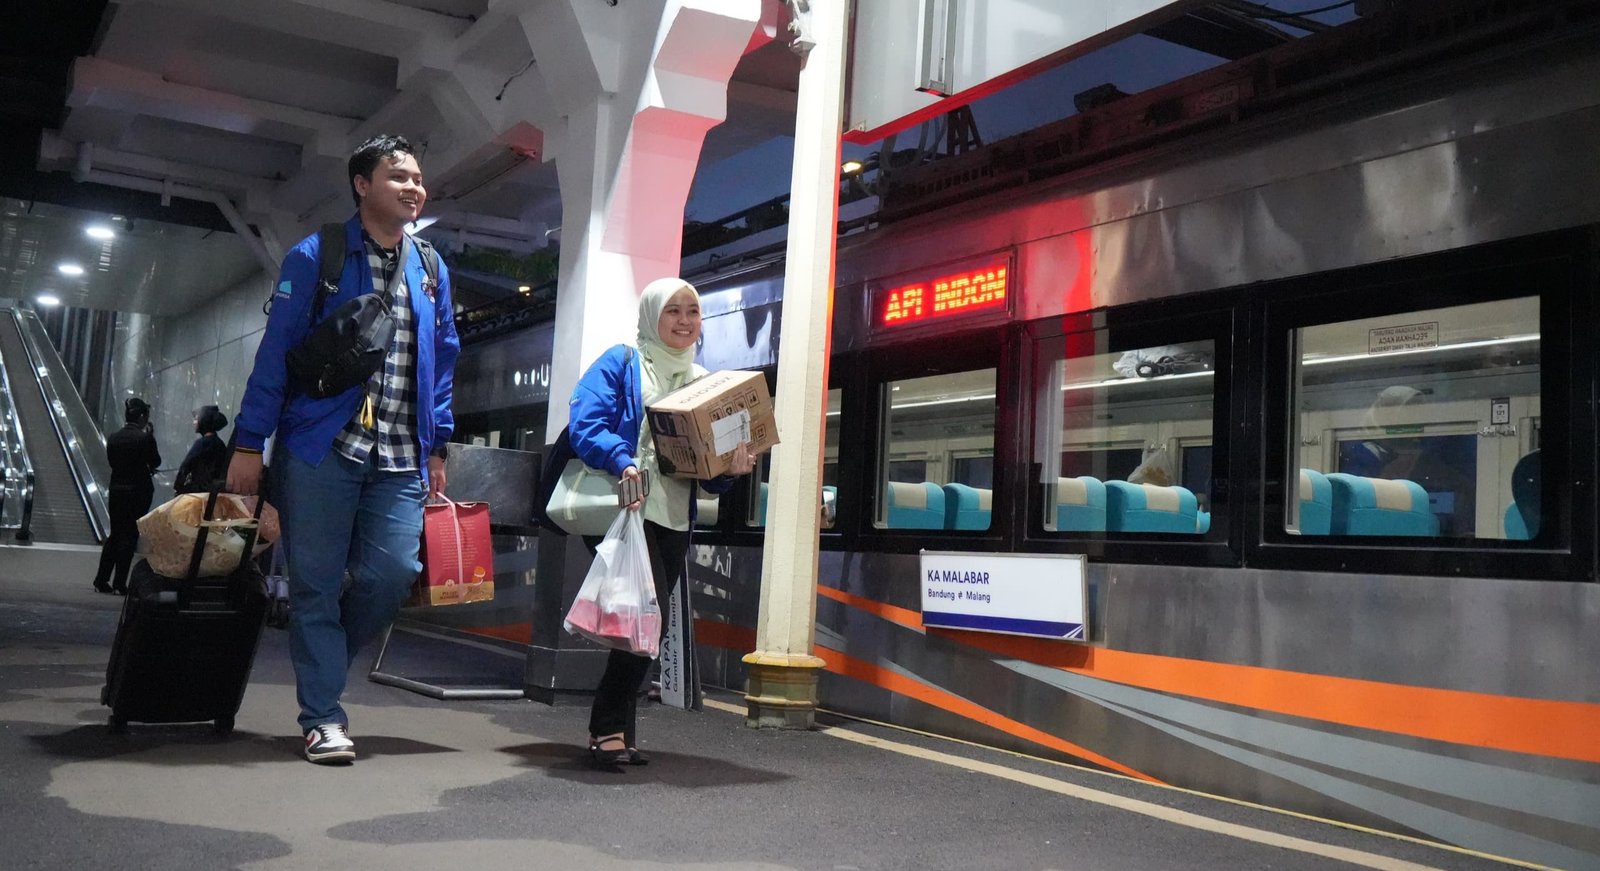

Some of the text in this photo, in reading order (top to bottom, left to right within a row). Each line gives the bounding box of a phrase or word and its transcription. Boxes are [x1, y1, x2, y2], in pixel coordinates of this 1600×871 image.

[885, 267, 1007, 321] API INDON
[927, 569, 990, 585] KA MALABAR
[928, 588, 991, 603] Bandung Malang
[664, 666, 671, 691] KA
